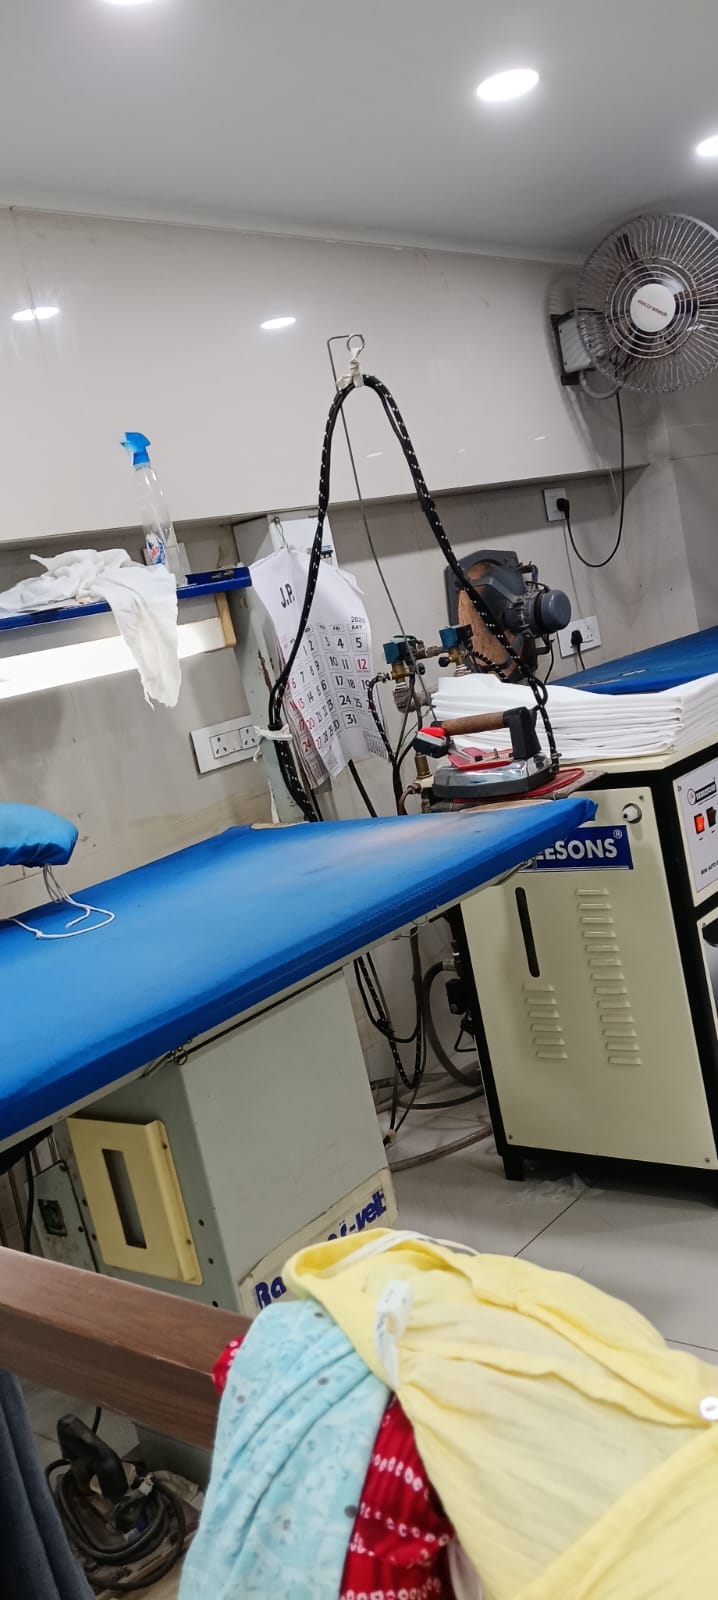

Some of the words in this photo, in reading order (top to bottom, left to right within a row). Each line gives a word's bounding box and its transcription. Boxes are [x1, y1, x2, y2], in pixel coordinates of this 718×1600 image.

[337, 638, 344, 649] 4
[355, 637, 363, 648] 5
[329, 656, 339, 667] 10
[342, 658, 350, 670] 11
[357, 658, 367, 670] 12
[335, 675, 344, 686] 17
[347, 678, 356, 689] 18
[338, 694, 352, 706] 24
[345, 713, 357, 725] 31
